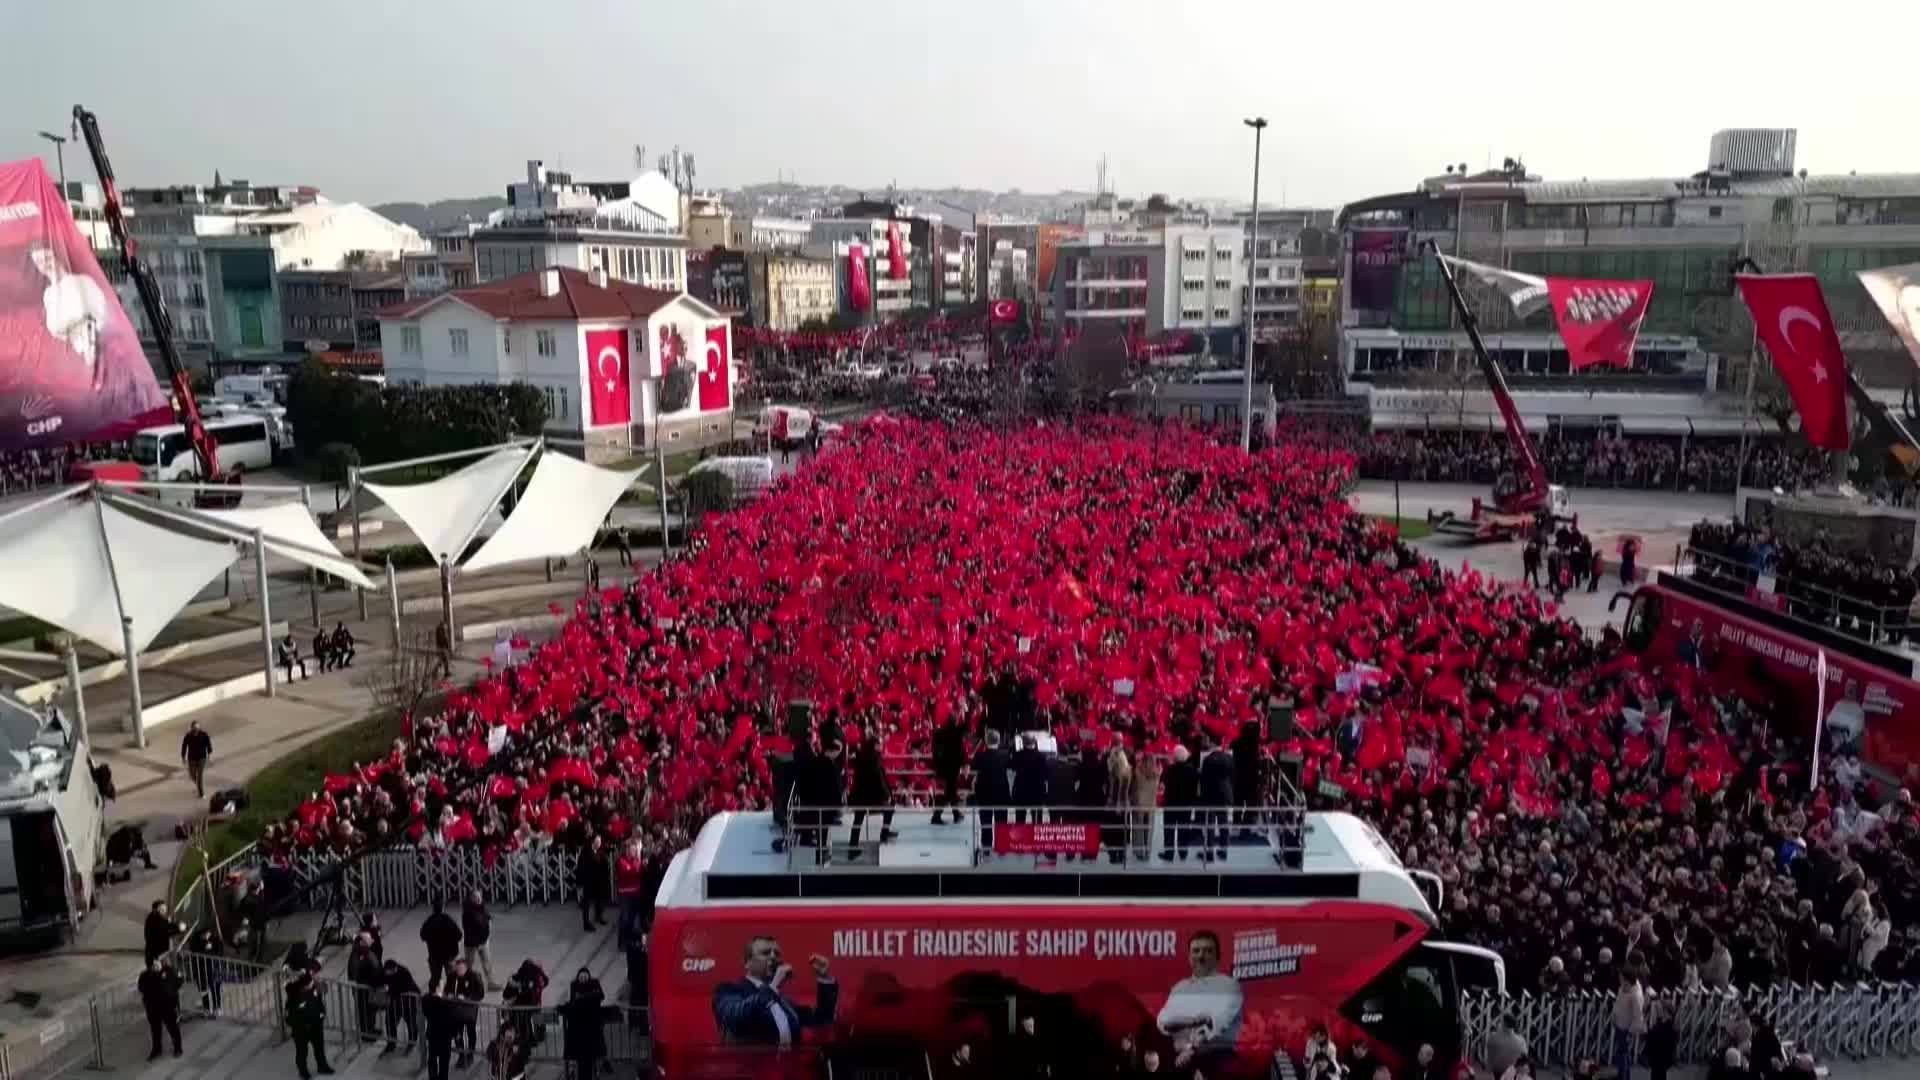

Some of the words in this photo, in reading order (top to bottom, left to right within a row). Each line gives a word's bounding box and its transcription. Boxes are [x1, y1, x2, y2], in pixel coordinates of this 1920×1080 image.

[26, 415, 62, 435] CHP
[1034, 833, 1053, 841] HALK
[833, 930, 906, 956] MİLLET
[914, 928, 1020, 956] İRADESİNE
[1026, 928, 1088, 956] SAHİP
[1094, 930, 1177, 960] ÇIKIYOR
[683, 958, 716, 971] CHP
[1361, 1013, 1383, 1023] CHP
